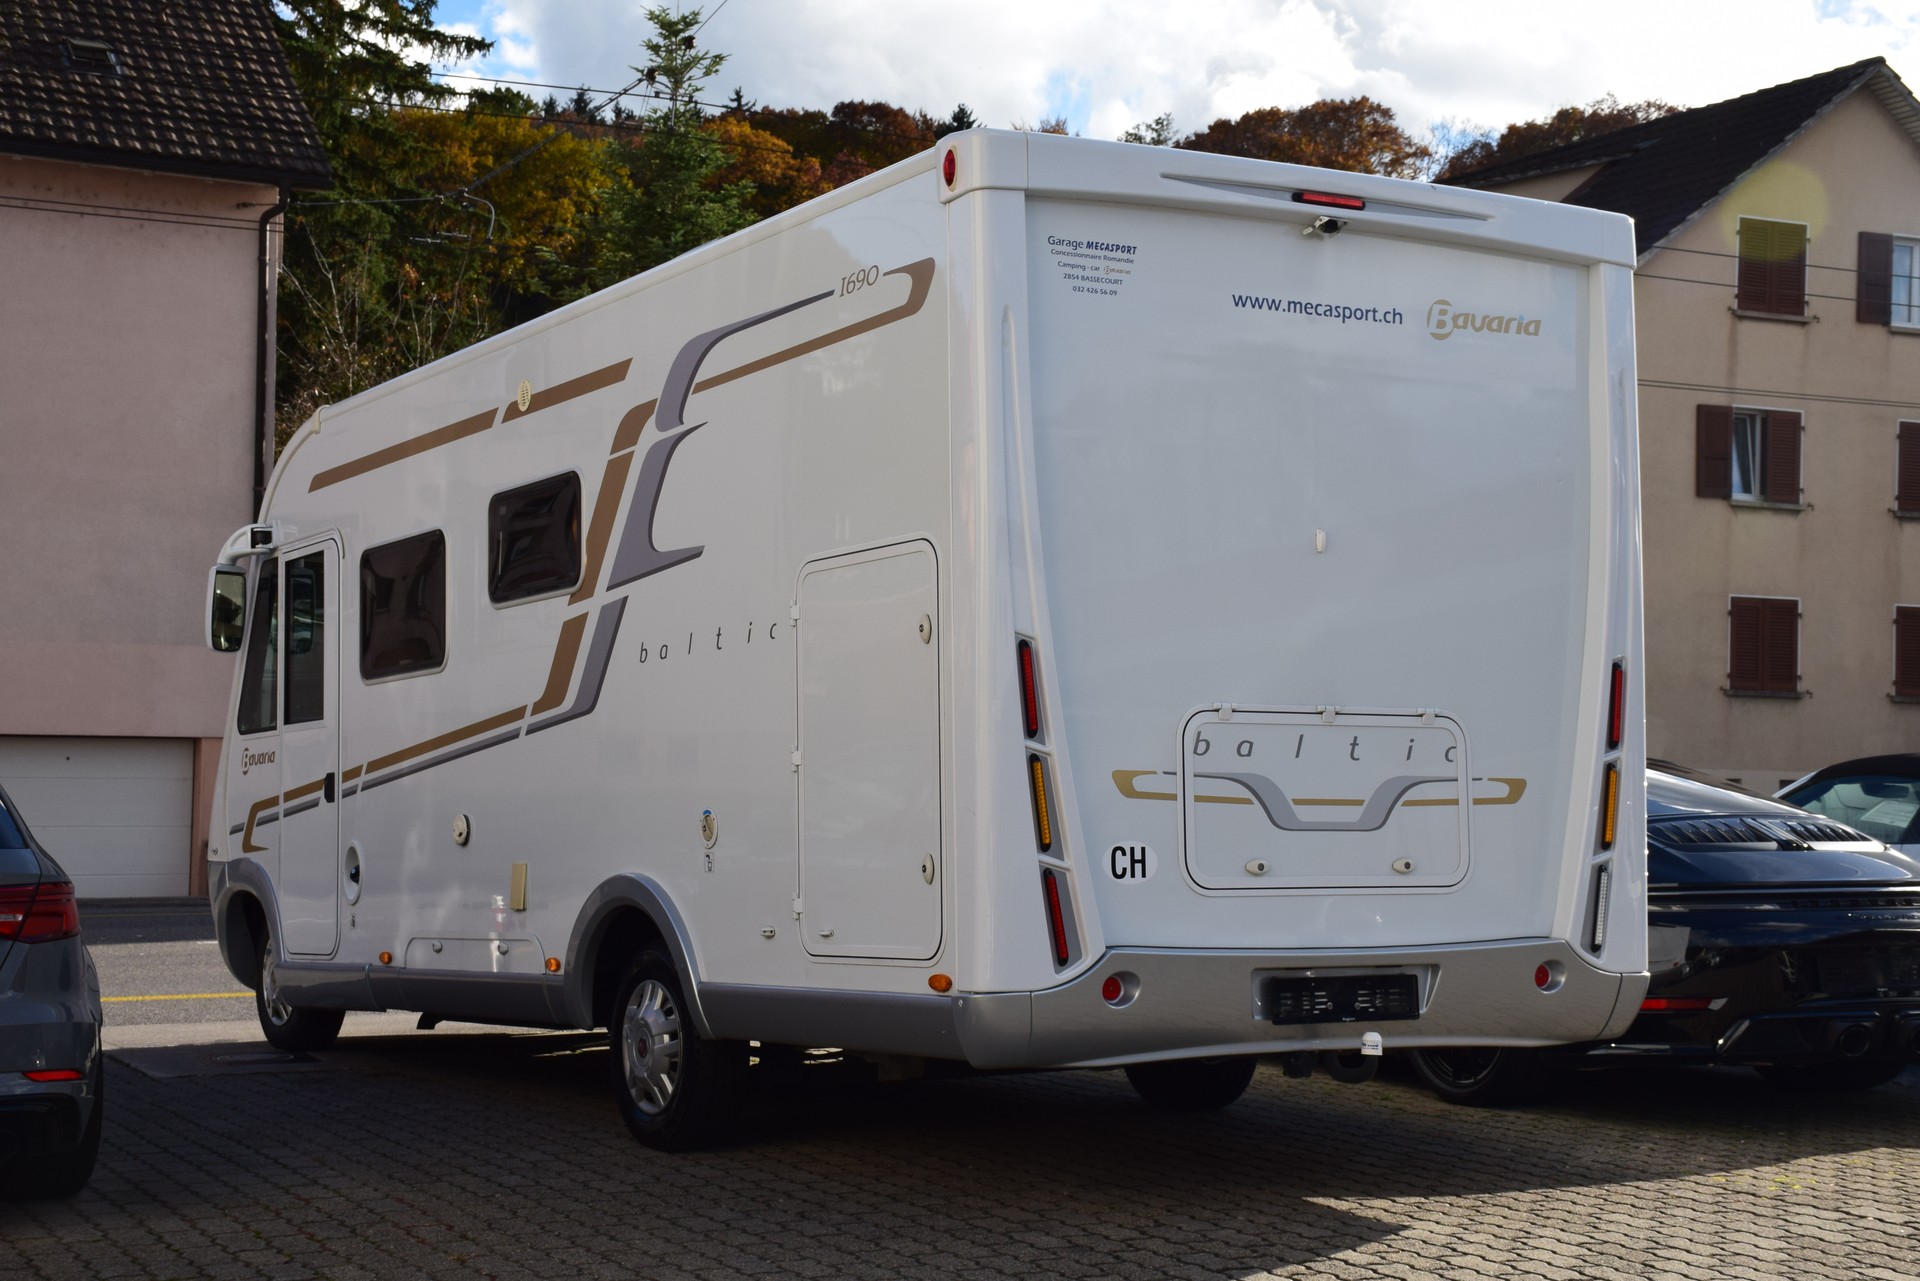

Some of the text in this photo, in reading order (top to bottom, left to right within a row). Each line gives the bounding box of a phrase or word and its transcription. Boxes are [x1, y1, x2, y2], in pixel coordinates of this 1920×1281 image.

[1047, 235, 1138, 255] Garage MECASPORT
[1050, 248, 1135, 264] Concessionnaire Romandie
[1057, 260, 1086, 271] Camping
[1063, 273, 1123, 285] 2854 BASSECOURT
[1231, 294, 1404, 324] www.mecasport.ch
[1426, 299, 1543, 341] Bavaria
[639, 621, 778, 664] baltic
[1192, 730, 1458, 764] baltic
[1110, 845, 1147, 880] CH
